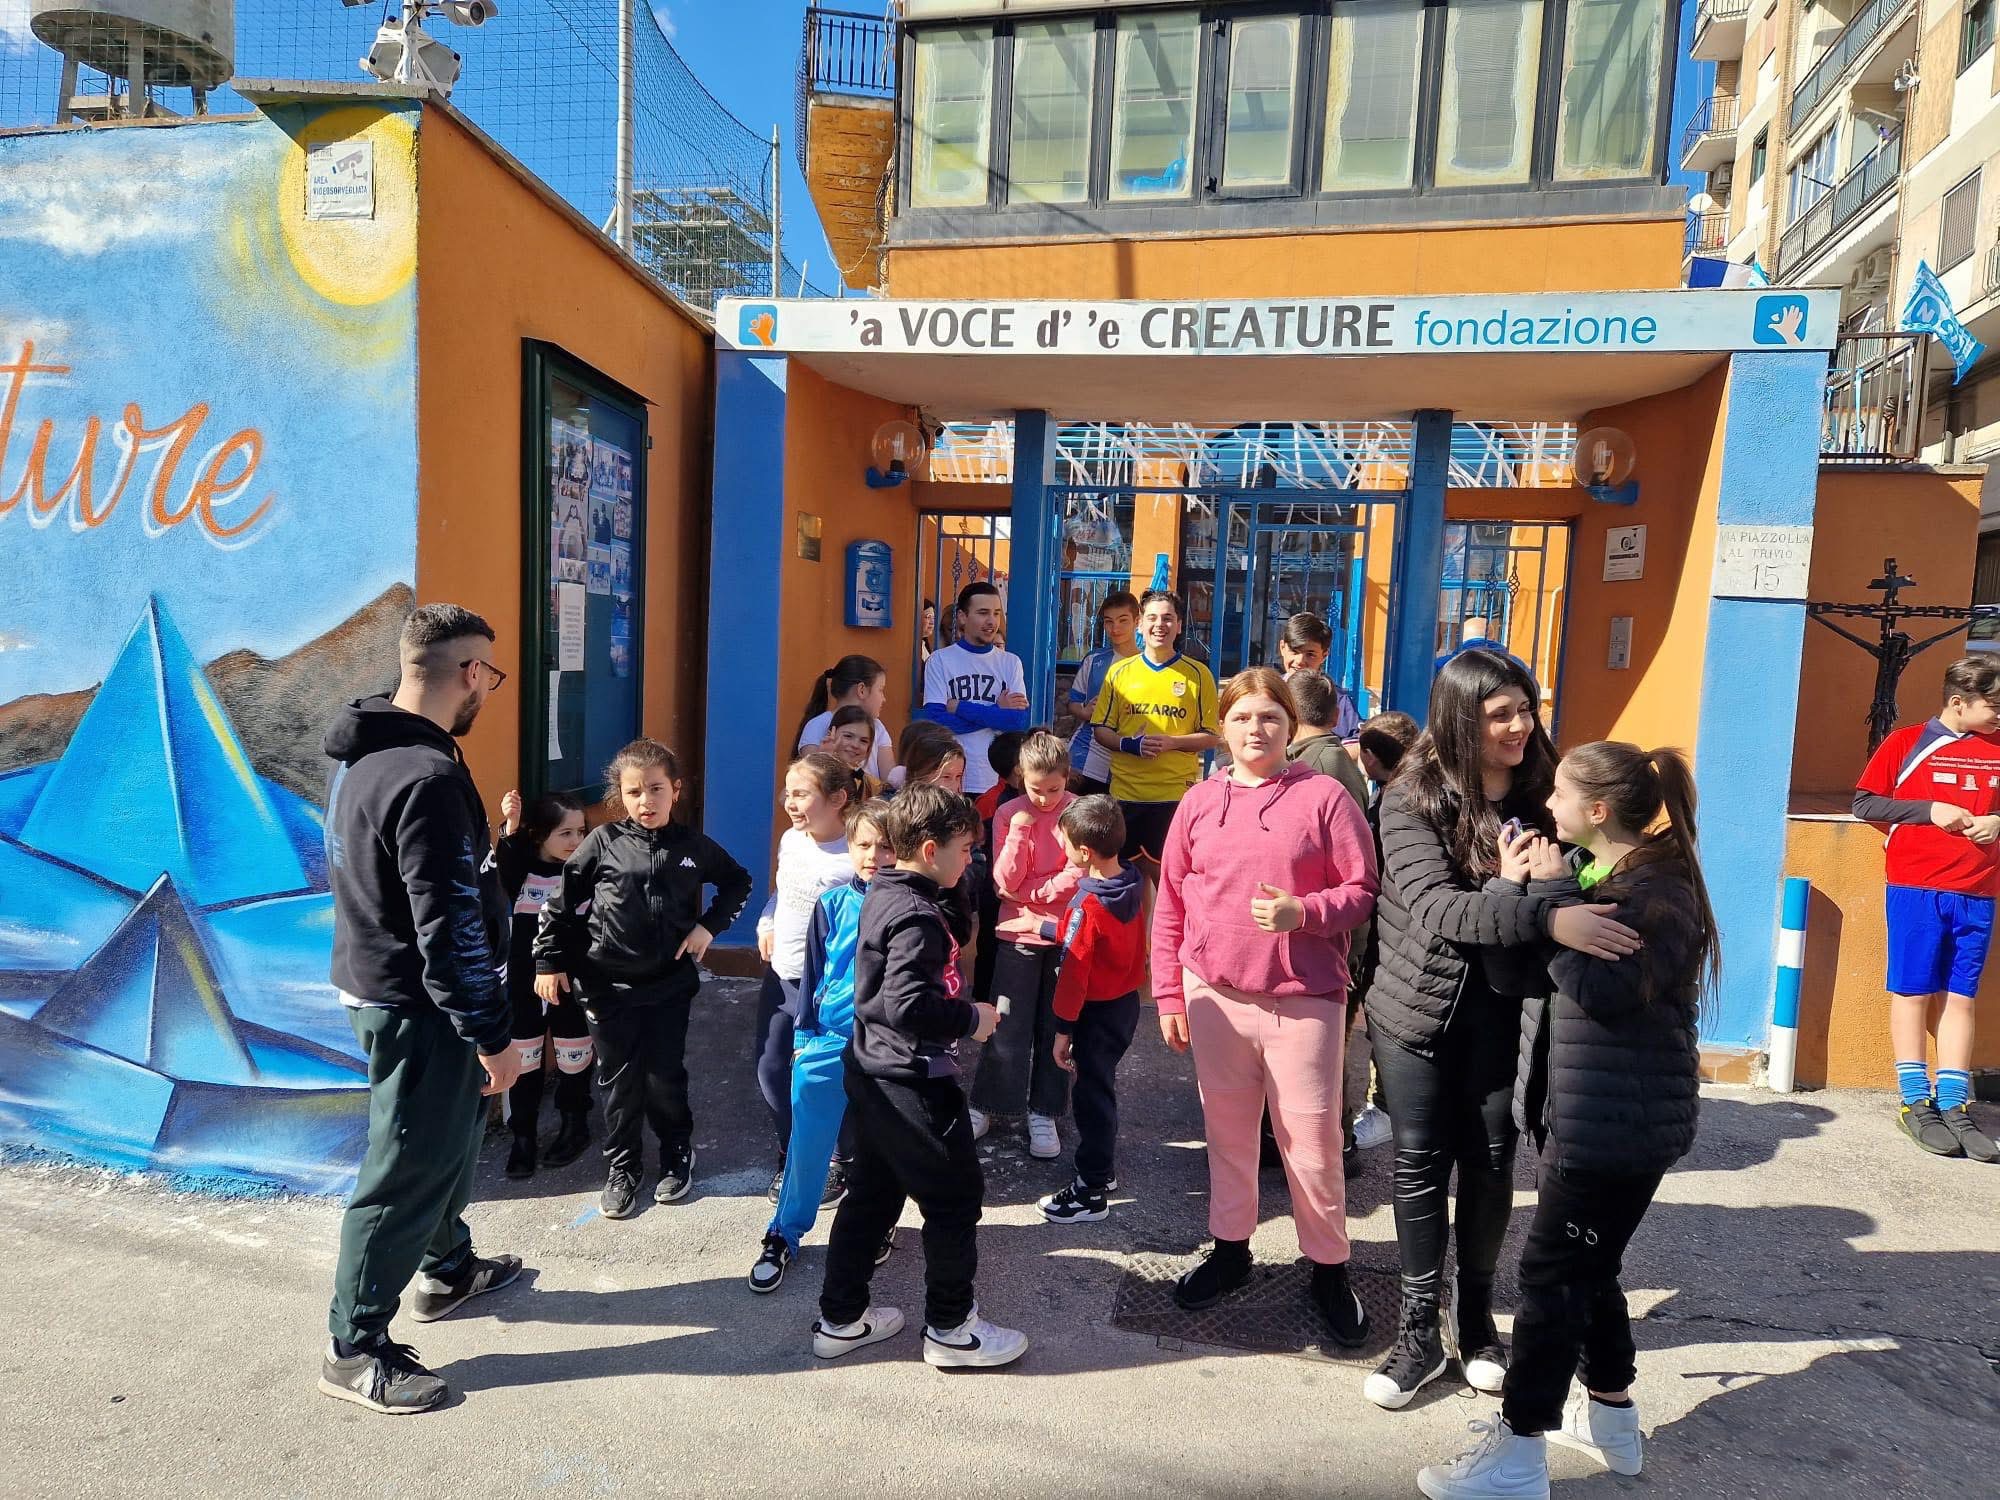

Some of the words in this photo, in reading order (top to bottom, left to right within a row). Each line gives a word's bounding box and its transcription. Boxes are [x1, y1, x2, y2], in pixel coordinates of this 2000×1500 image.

[313, 176, 328, 184] AREA
[313, 186, 368, 195] VIDEOSORVEGLIATA
[898, 307, 1015, 348] VOCE
[1140, 304, 1395, 348] CREATURE
[1414, 308, 1657, 346] fondazione
[1740, 531, 1810, 544] PIAZZOLLA
[1752, 564, 1784, 592] 15
